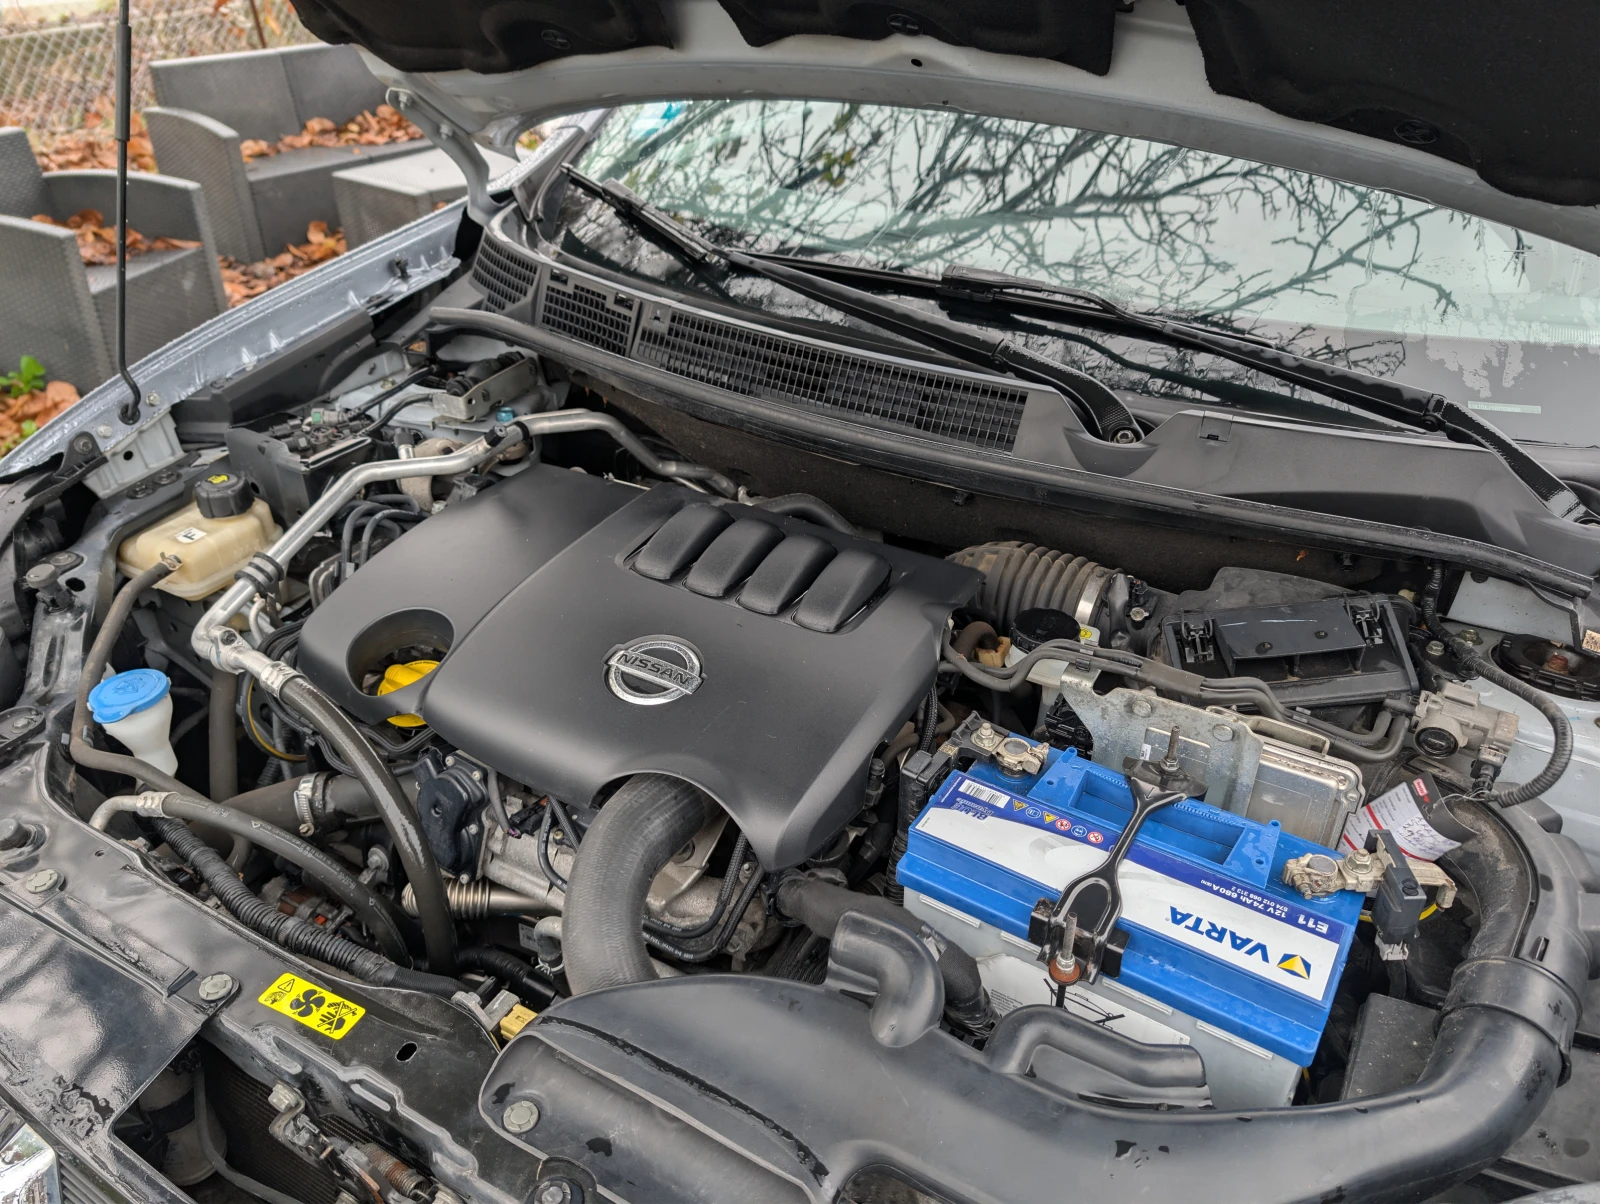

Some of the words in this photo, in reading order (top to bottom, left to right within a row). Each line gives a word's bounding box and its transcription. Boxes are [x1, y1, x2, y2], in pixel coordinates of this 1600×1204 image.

[617, 653, 690, 685] NISSAN
[950, 802, 988, 821] BLUE
[1212, 884, 1238, 898] 680A
[1240, 896, 1264, 910] 74Ah
[1262, 898, 1275, 906] 012
[1276, 903, 1288, 912] 574
[1266, 906, 1286, 918] 12V
[1298, 914, 1330, 934] E11
[1170, 906, 1270, 964] VARTA
